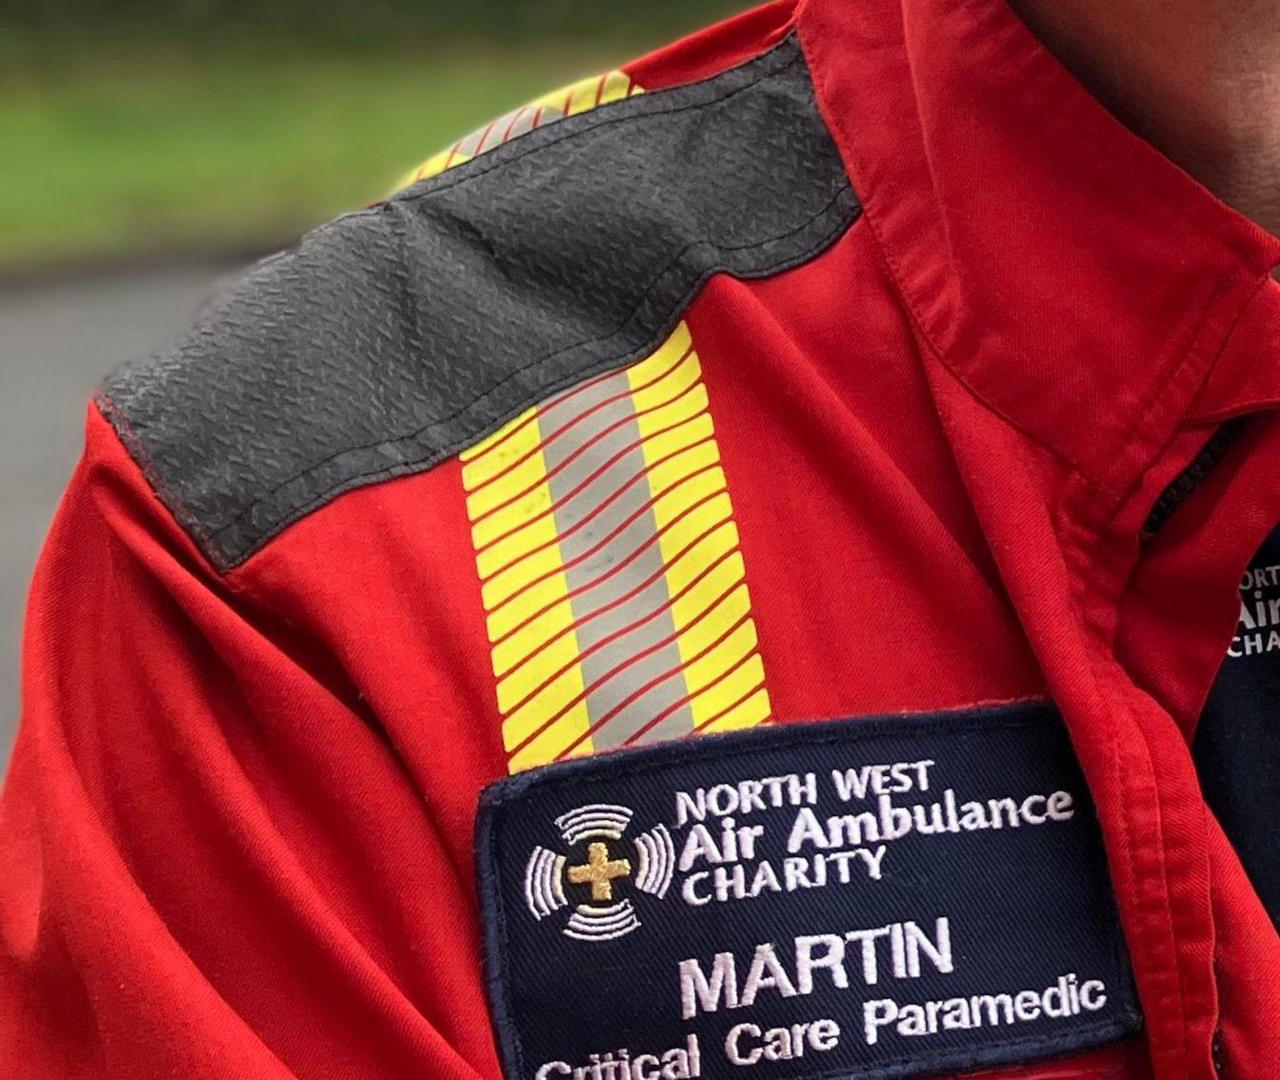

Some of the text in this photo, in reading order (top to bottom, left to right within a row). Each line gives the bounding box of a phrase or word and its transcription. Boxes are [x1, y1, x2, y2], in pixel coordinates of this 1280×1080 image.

[676, 760, 935, 823] NORTH WEST
[677, 788, 1075, 871] Air Ambulance
[681, 846, 887, 905] CHARITY
[677, 917, 954, 1019] MARTIN
[724, 1019, 840, 1066] Care
[862, 975, 1107, 1045] Paramedic
